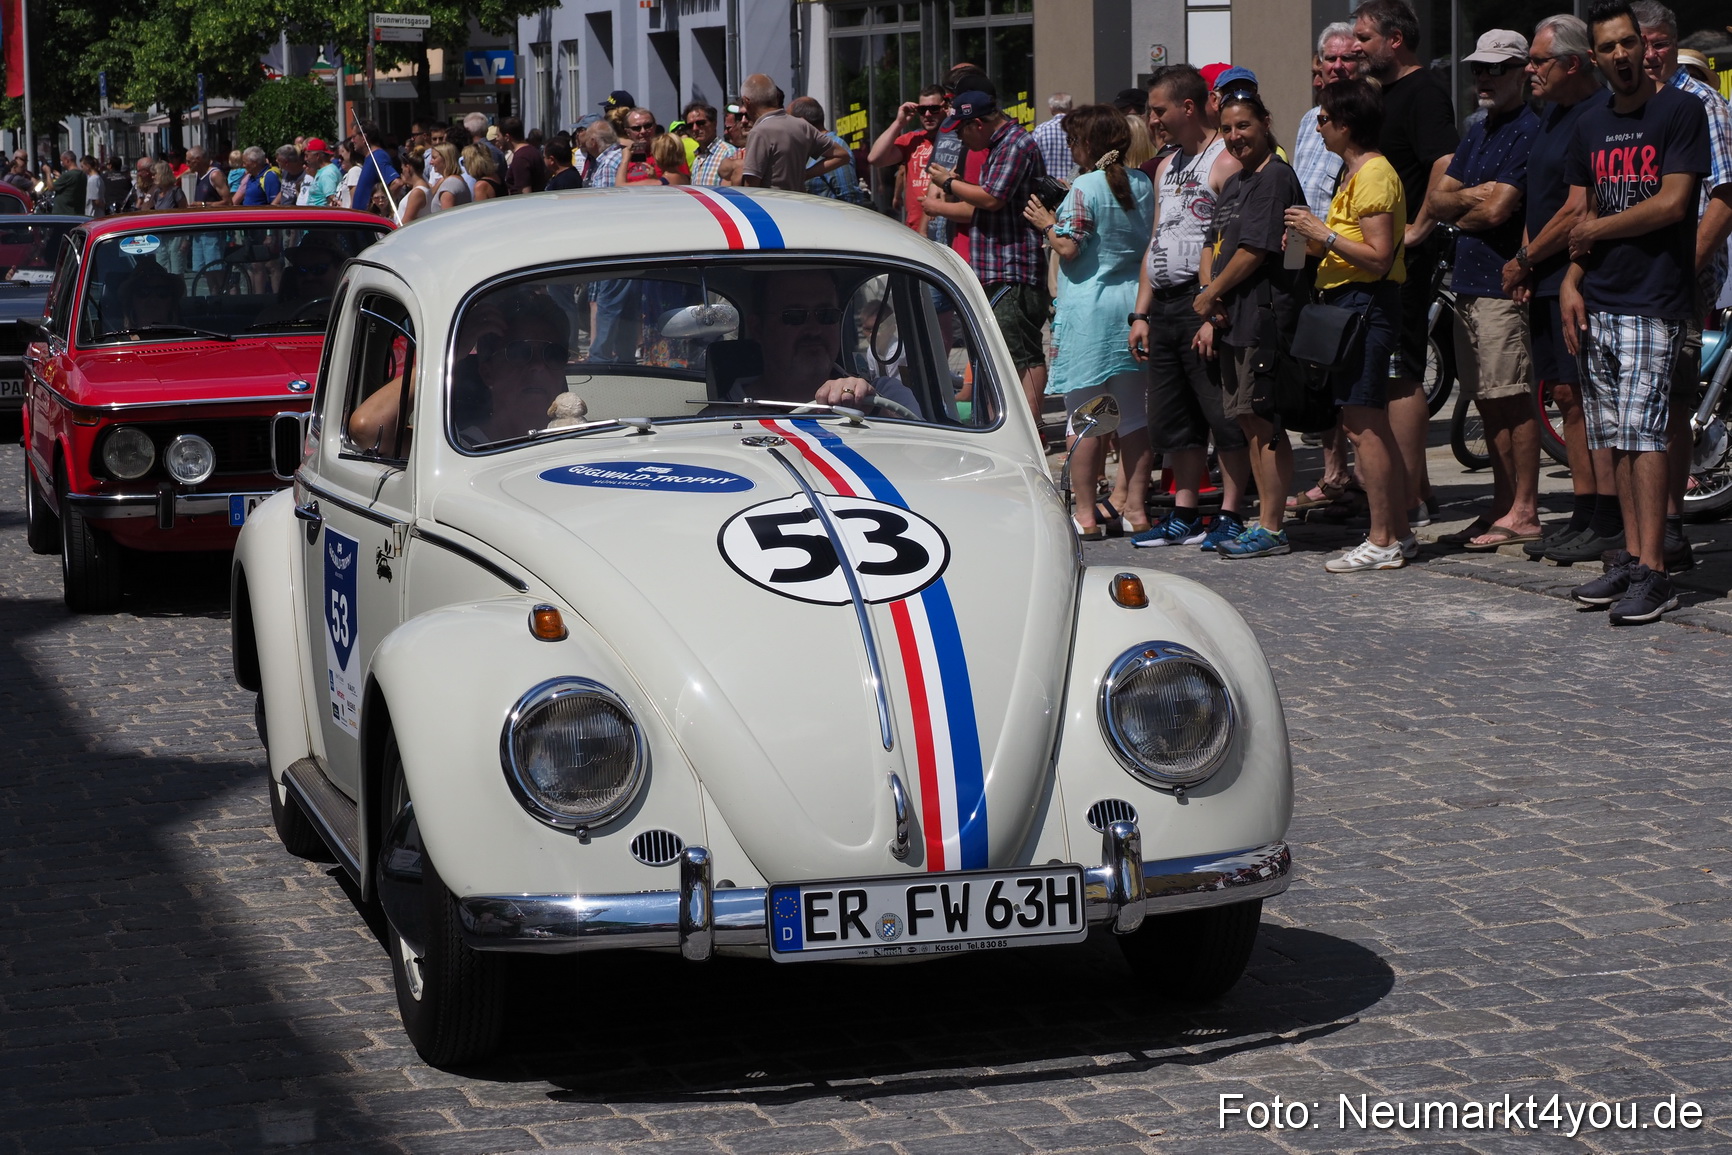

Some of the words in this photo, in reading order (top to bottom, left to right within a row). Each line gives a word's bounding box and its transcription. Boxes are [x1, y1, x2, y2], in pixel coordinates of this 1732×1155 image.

[1640, 144, 1659, 182] &
[1, 381, 24, 396] PA
[568, 465, 740, 486] GUGLWALD-TROPHY
[744, 507, 930, 583] 53
[331, 588, 349, 648] 53
[782, 926, 793, 941] D
[803, 889, 871, 942] ER
[906, 882, 970, 935] FW
[985, 876, 1077, 930] 63H
[935, 943, 962, 952] Kassel
